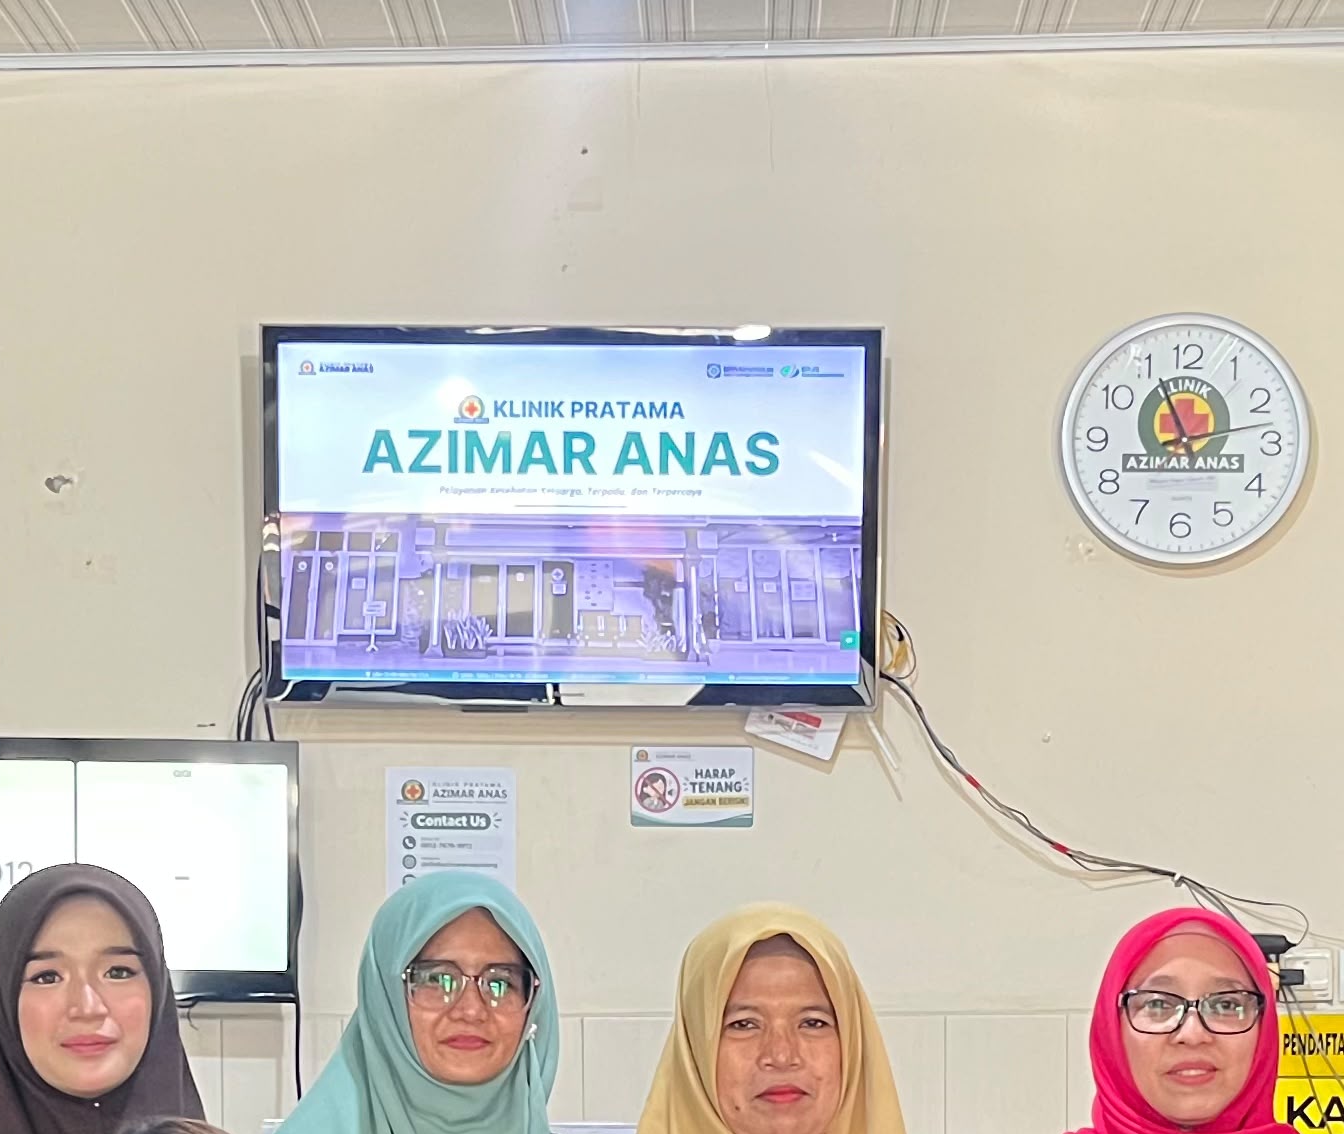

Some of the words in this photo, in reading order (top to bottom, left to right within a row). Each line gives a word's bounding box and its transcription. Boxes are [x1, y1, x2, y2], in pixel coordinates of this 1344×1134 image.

[1173, 343, 1204, 370] 12
[1229, 356, 1238, 381] 1
[494, 400, 564, 418] KLINIK
[571, 400, 685, 419] PRATAMA
[1102, 384, 1134, 410] 10
[1249, 388, 1271, 414] 2
[1086, 426, 1109, 452] 9
[1259, 430, 1282, 456] 3
[362, 429, 597, 475] AZIMAR
[613, 430, 780, 477] ANAS
[1126, 456, 1190, 469] AZIMAR
[1194, 456, 1240, 469] ANAS
[1098, 468, 1120, 495] 8
[1244, 472, 1266, 498] 4
[1129, 499, 1150, 525] 7
[1169, 512, 1192, 538] 6
[1211, 501, 1234, 527] 5
[695, 768, 736, 779] HARAP
[432, 789, 475, 799] AZIMAR
[477, 789, 508, 799] ANAS
[689, 781, 742, 793] TENANG
[415, 814, 468, 827] Contact
[469, 814, 487, 828] Us
